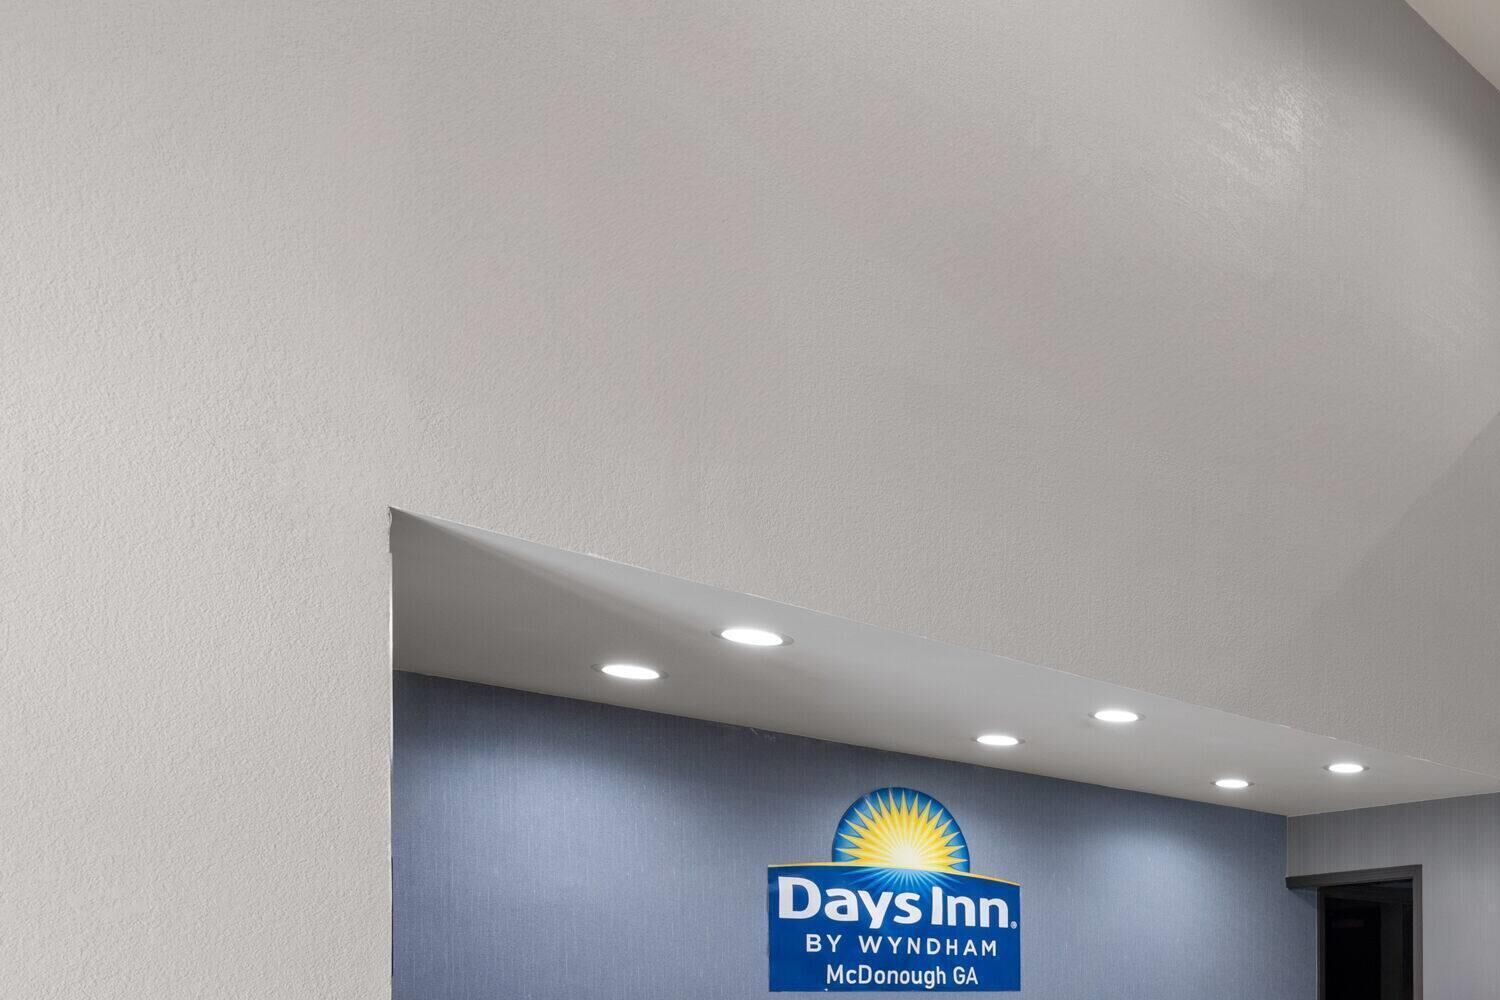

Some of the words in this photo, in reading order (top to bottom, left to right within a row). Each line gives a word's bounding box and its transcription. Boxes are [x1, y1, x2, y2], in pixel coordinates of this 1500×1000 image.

[778, 876, 922, 929] Days
[931, 886, 1009, 929] Inn
[806, 934, 842, 953] BY
[858, 935, 997, 957] WYNDHAM
[826, 964, 947, 989] McDonough
[953, 966, 979, 985] GA
